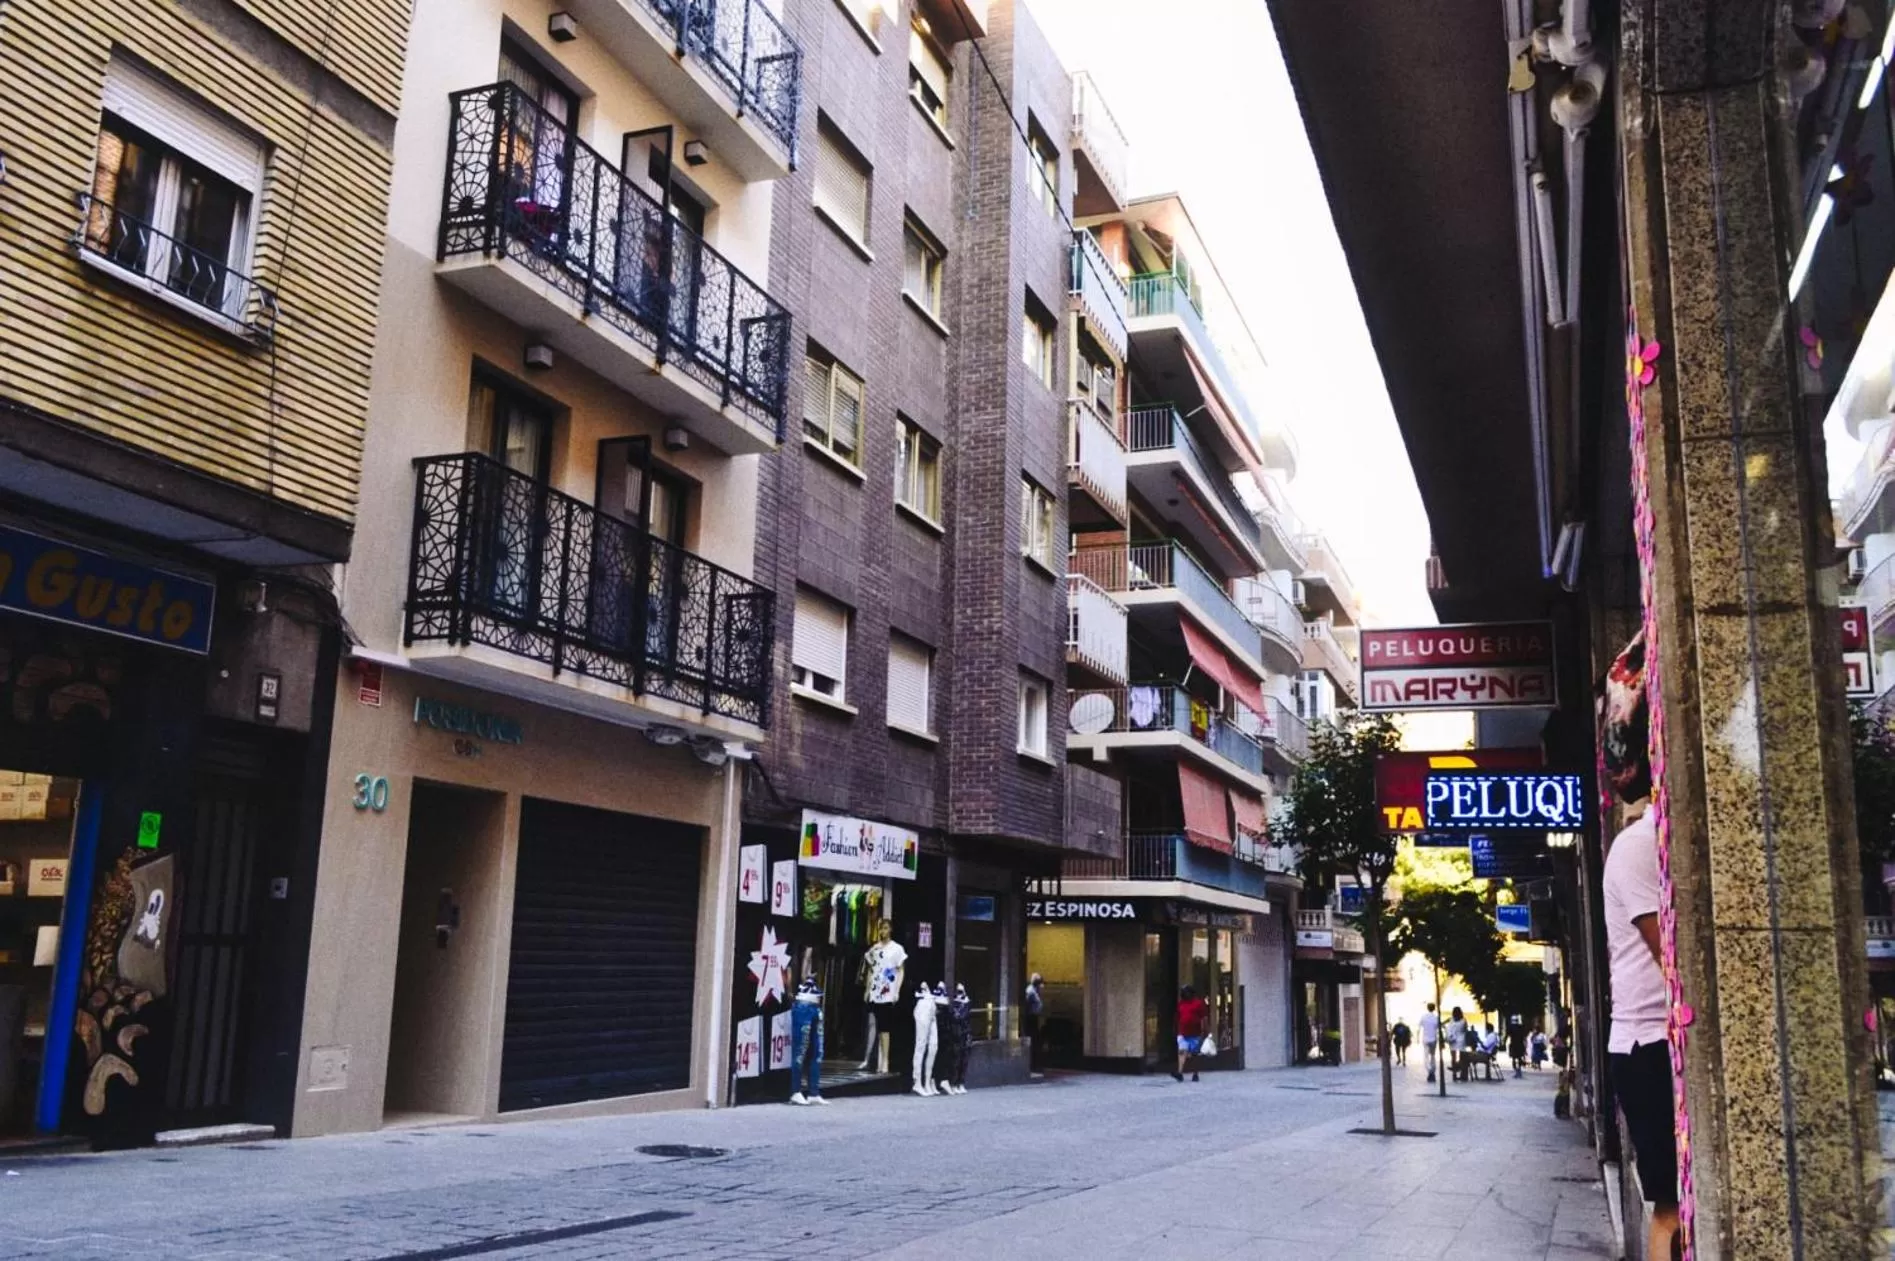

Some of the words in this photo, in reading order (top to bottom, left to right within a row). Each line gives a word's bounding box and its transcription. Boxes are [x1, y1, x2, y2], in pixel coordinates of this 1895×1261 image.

[26, 551, 193, 640] Gusto
[353, 773, 389, 813] 30
[822, 822, 859, 857] Fashion
[1045, 901, 1135, 918] ESPINOSA
